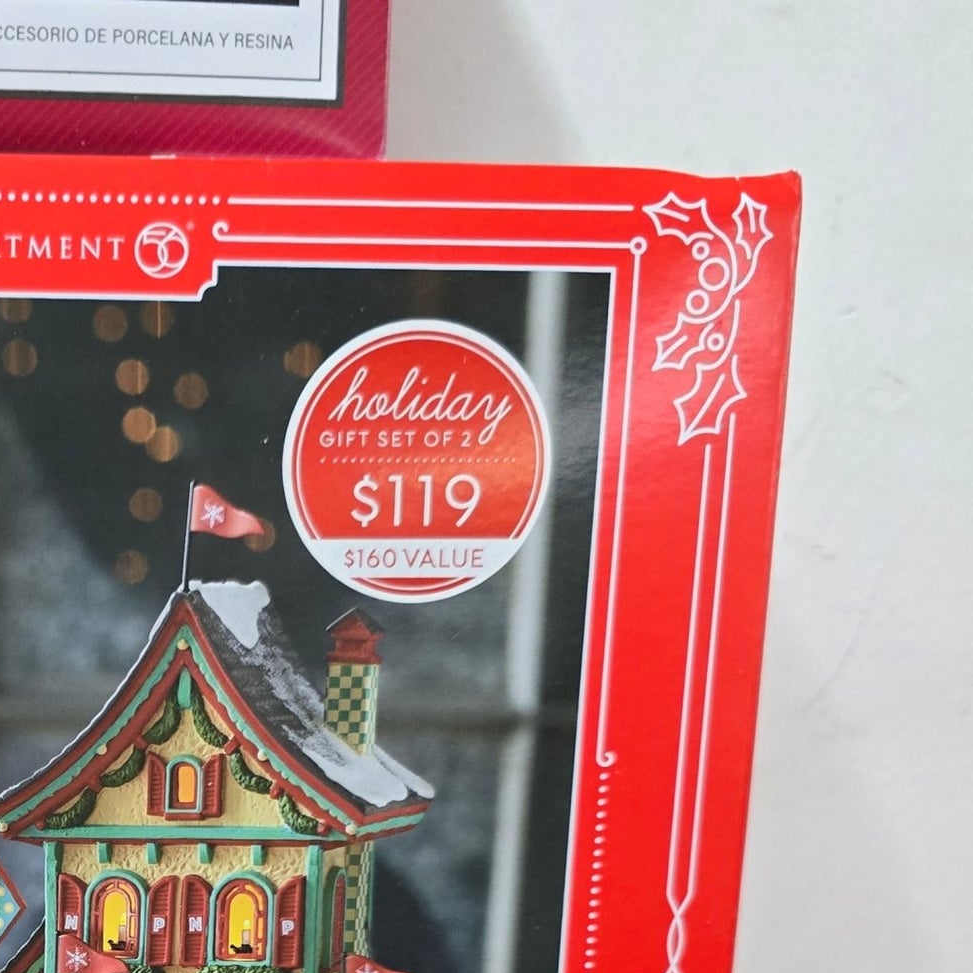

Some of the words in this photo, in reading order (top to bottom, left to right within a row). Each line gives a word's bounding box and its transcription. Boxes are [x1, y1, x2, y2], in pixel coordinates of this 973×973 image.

[85, 28, 107, 43] DE
[113, 29, 214, 47] PORCELANA
[218, 33, 230, 47] Y
[235, 33, 294, 50] RESINA
[328, 366, 512, 446] holiday
[319, 431, 369, 448] GIFT
[377, 431, 417, 448] SET
[423, 431, 453, 448] OF
[461, 431, 472, 448] 2
[350, 473, 481, 528] $119
[344, 548, 397, 570] $160
[403, 548, 484, 569] VALUE
[65, 915, 78, 930] N
[153, 917, 166, 932] P
[189, 917, 203, 932] N
[281, 920, 295, 935] P
